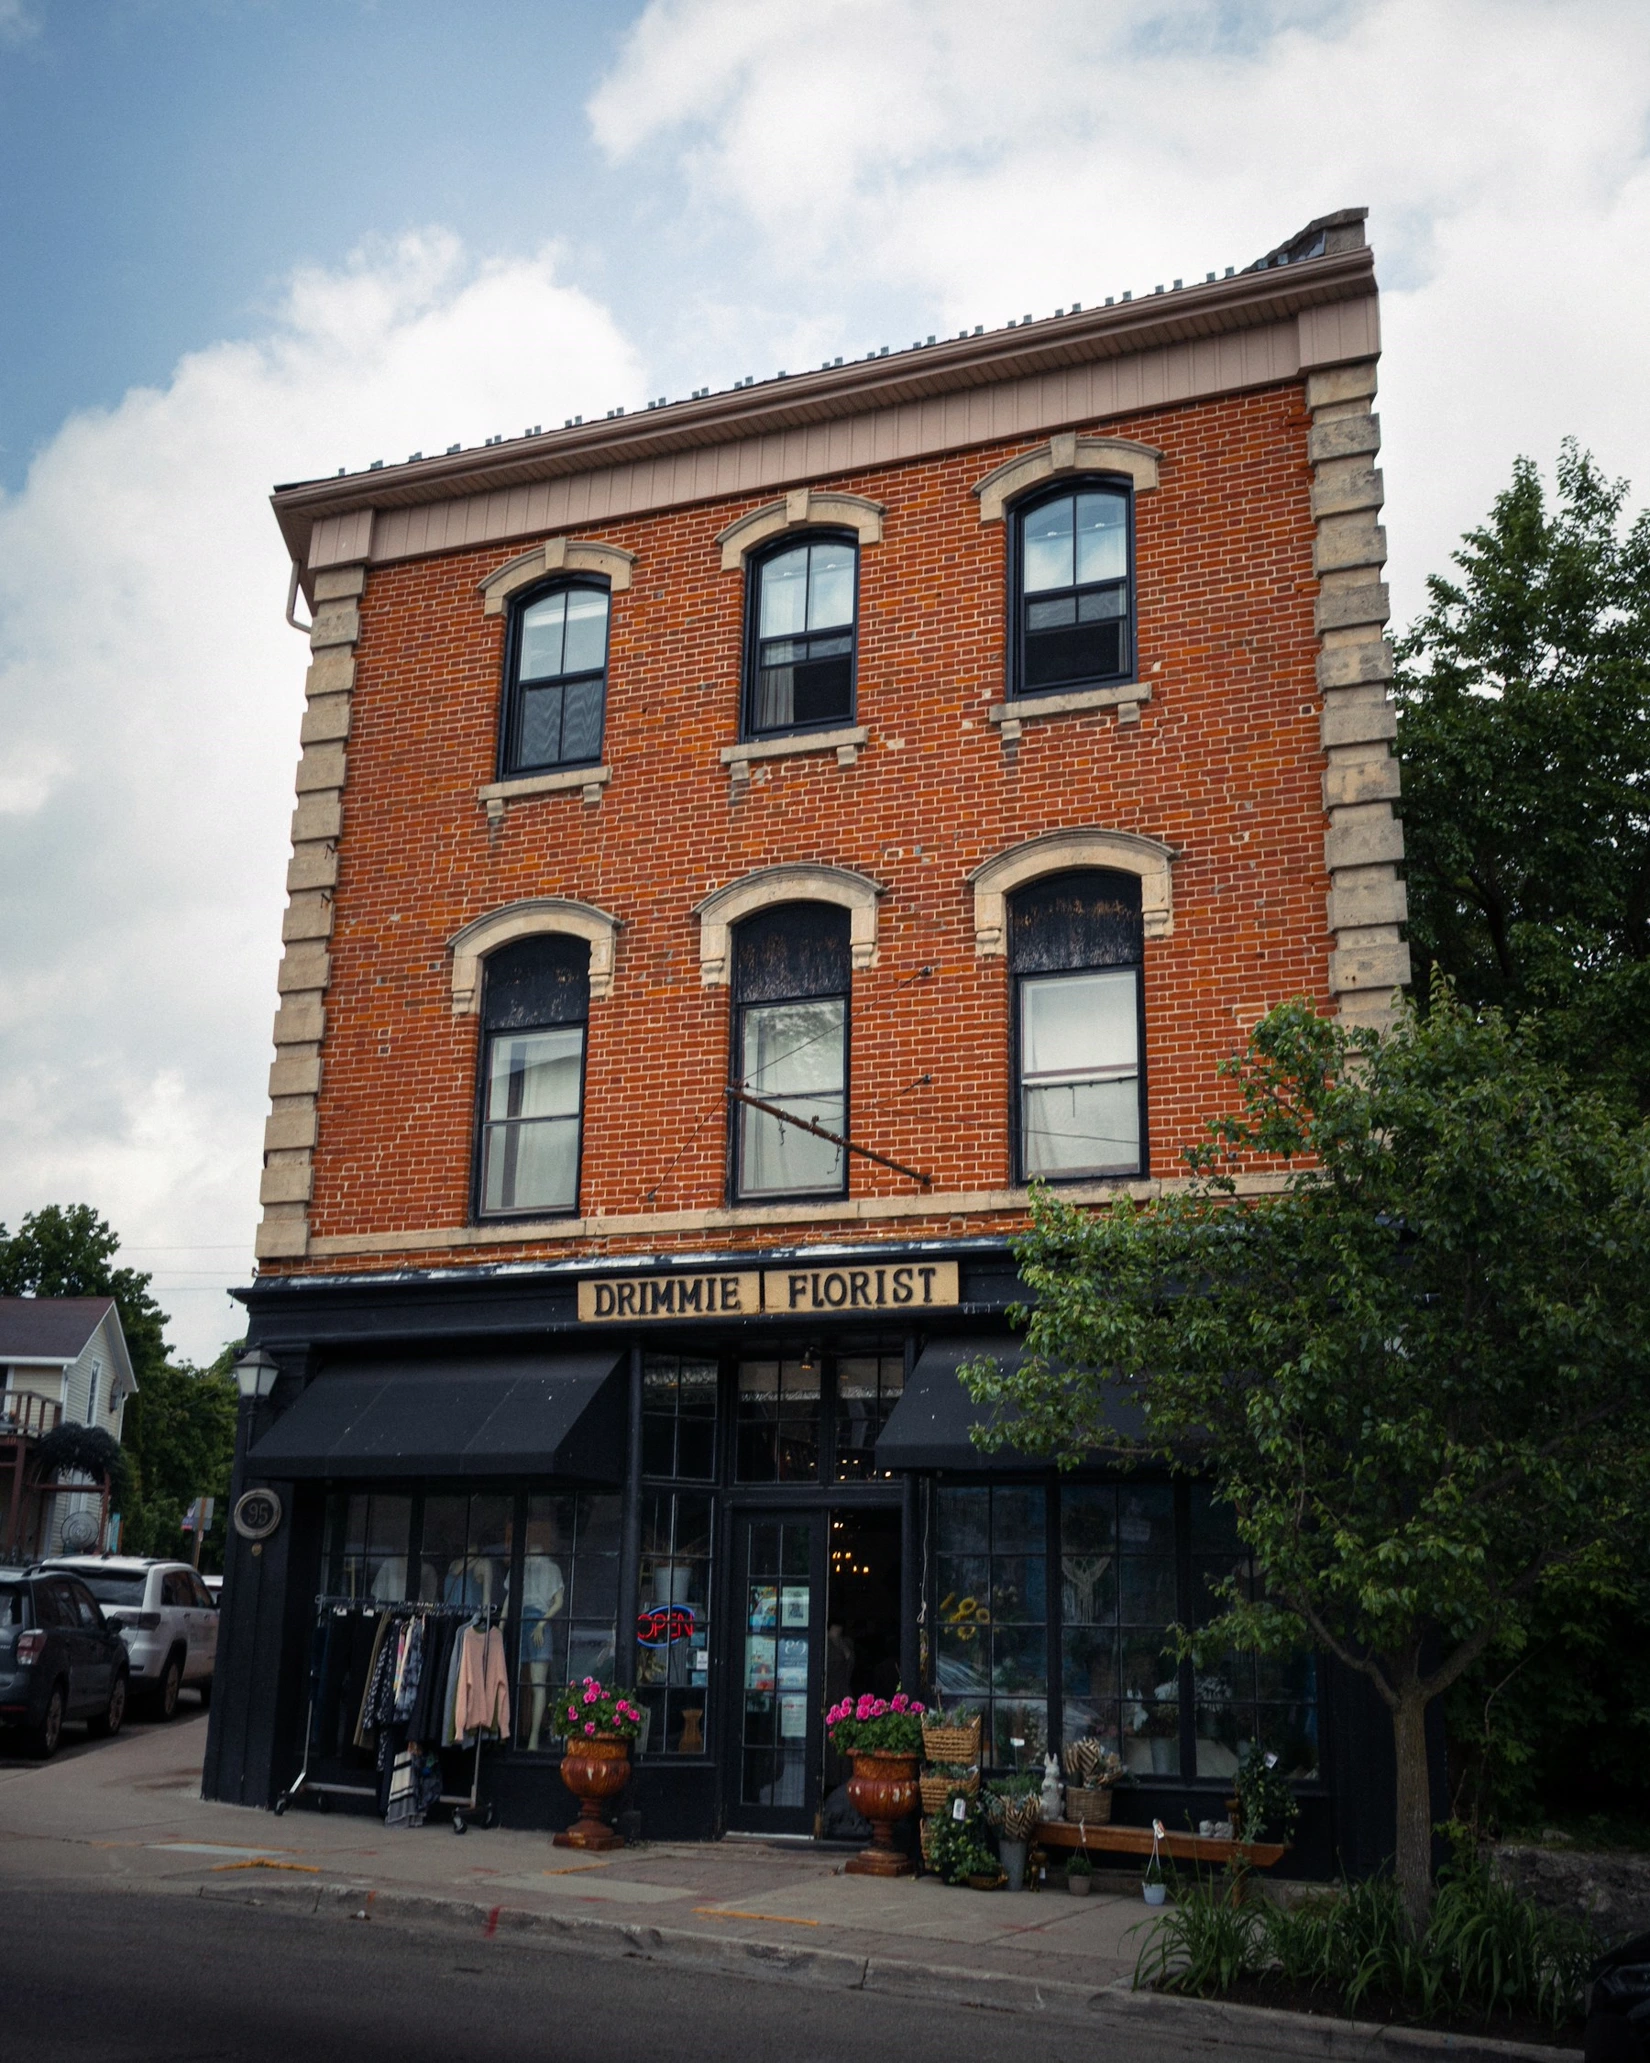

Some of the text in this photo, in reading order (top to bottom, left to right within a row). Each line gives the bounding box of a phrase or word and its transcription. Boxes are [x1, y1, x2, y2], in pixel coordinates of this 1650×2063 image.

[594, 1267, 937, 1317] DRIMMIE FLORIST
[248, 1503, 268, 1526] 95
[637, 1612, 695, 1640] OPEN
